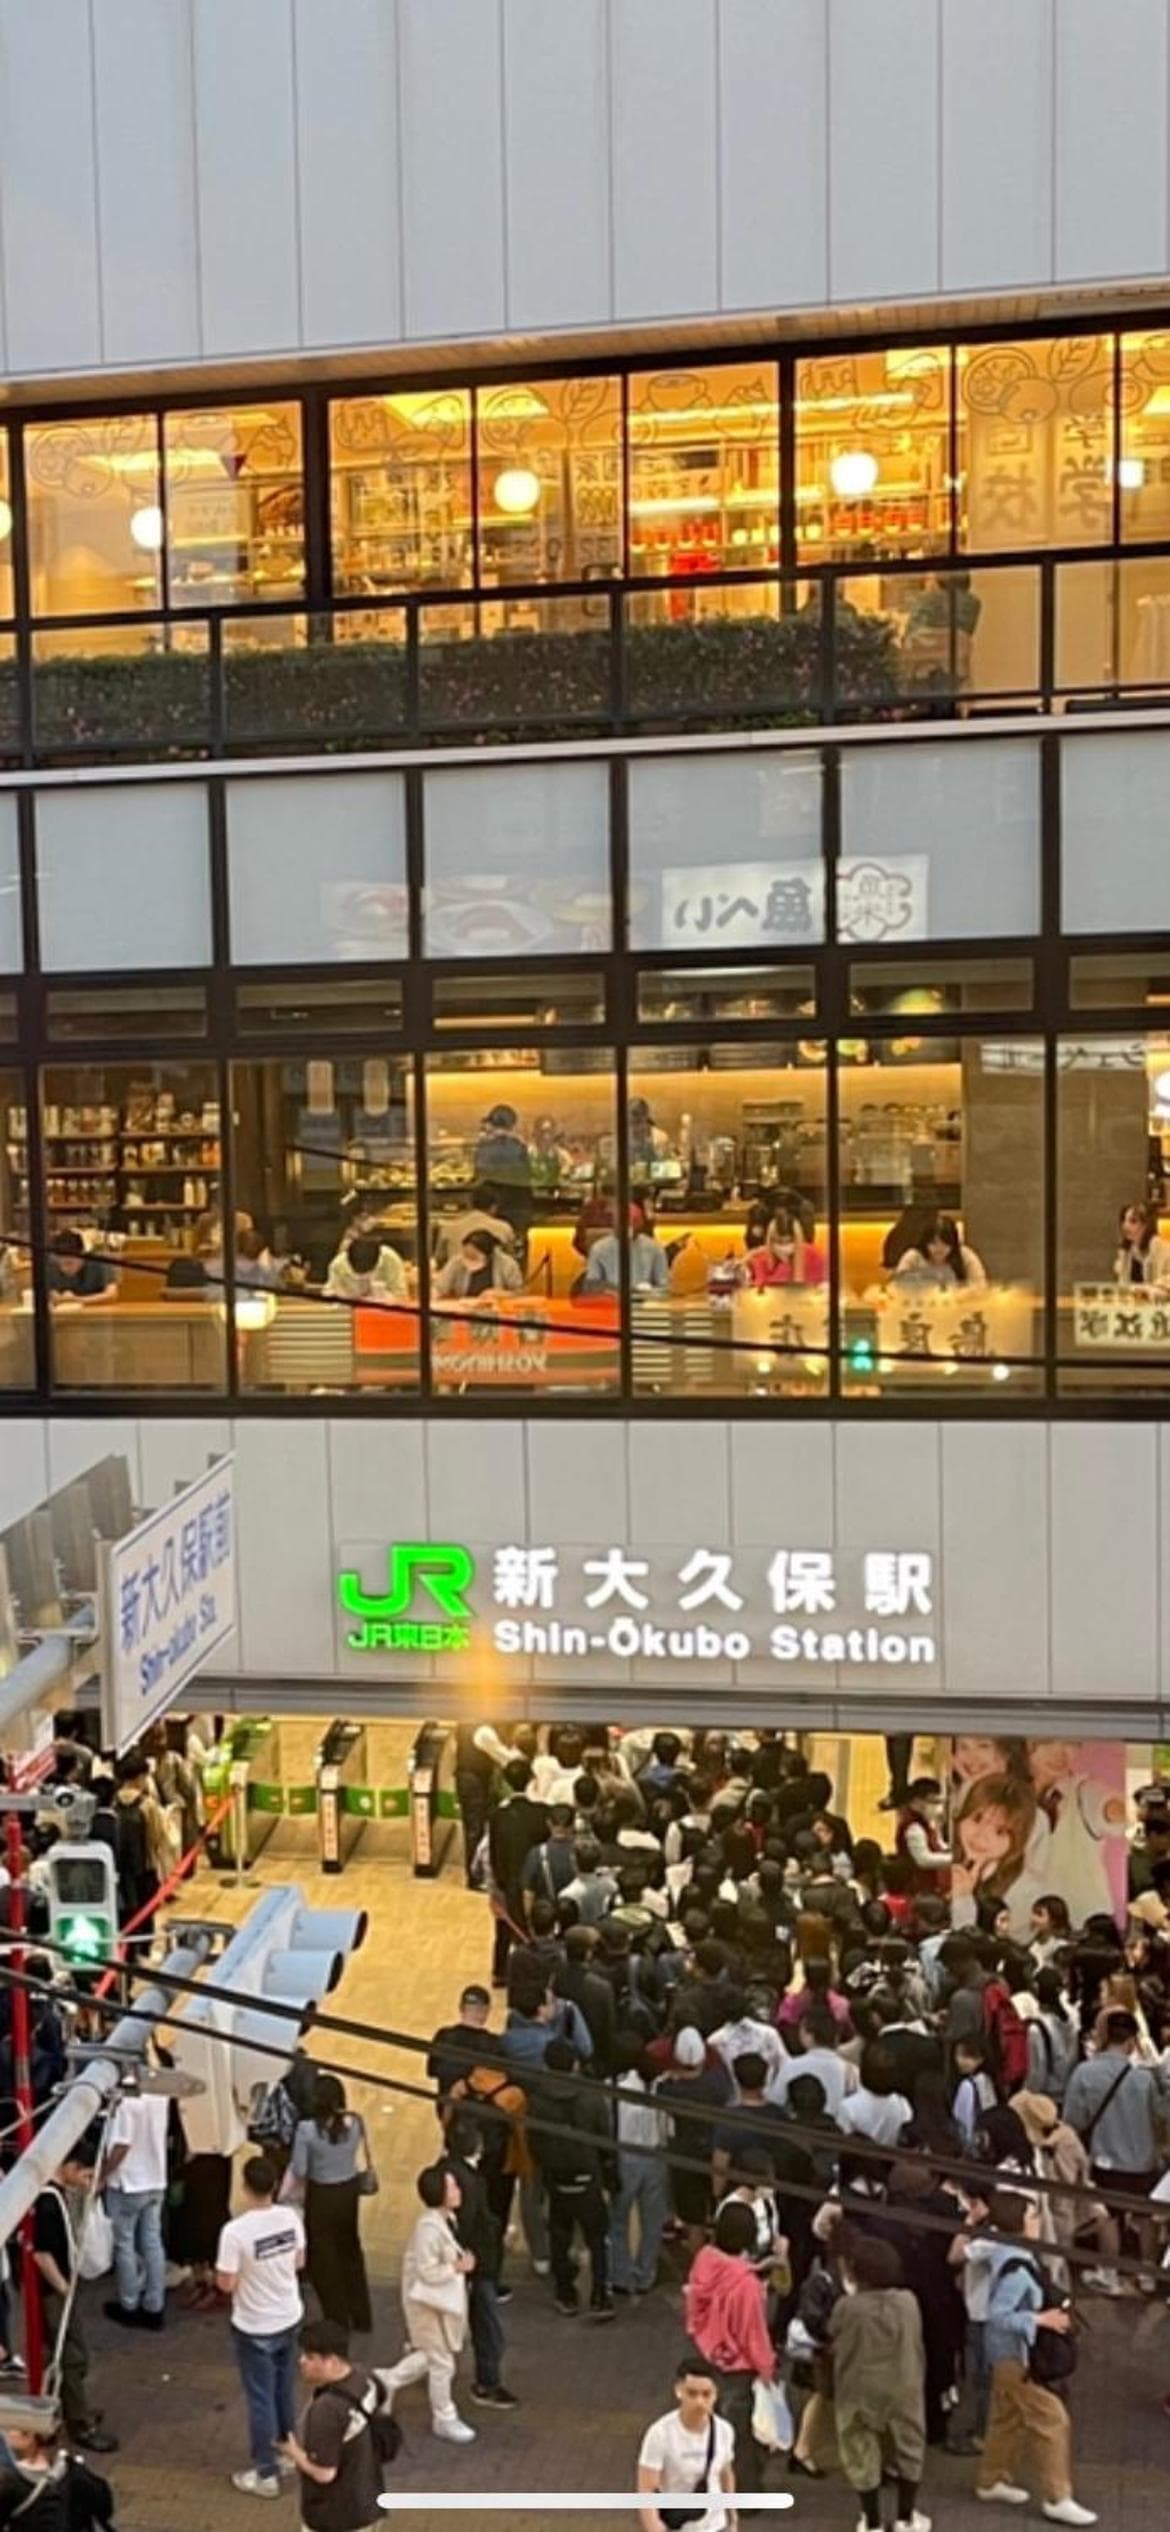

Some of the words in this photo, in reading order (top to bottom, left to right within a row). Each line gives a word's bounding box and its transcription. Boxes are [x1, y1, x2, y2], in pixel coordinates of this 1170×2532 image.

[120, 1491, 231, 1653] 新大久保駅前
[339, 1543, 474, 1618] JR
[494, 1545, 933, 1614] 新大久保駅
[770, 1625, 936, 1662] Station
